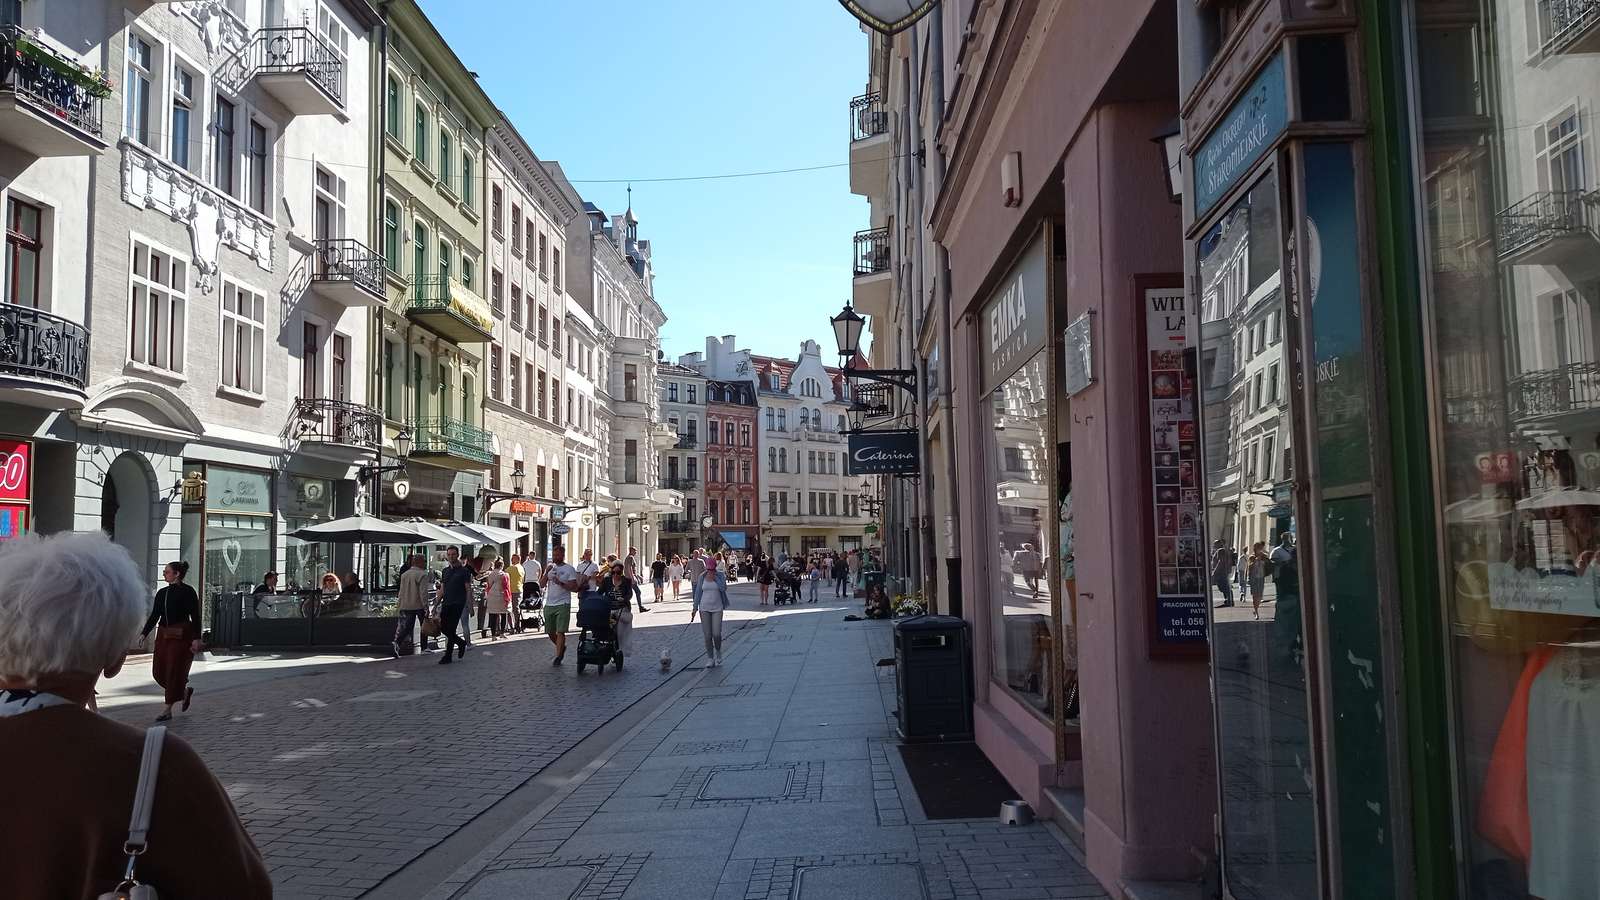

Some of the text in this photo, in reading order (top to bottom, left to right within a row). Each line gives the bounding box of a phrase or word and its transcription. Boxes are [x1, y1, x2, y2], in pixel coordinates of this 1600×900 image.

[991, 273, 1027, 354] EMKA
[992, 328, 1028, 377] FASHION
[854, 446, 914, 462] Caterina
[1171, 617, 1204, 626] tel. 056
[1163, 627, 1203, 637] tel. kom.
